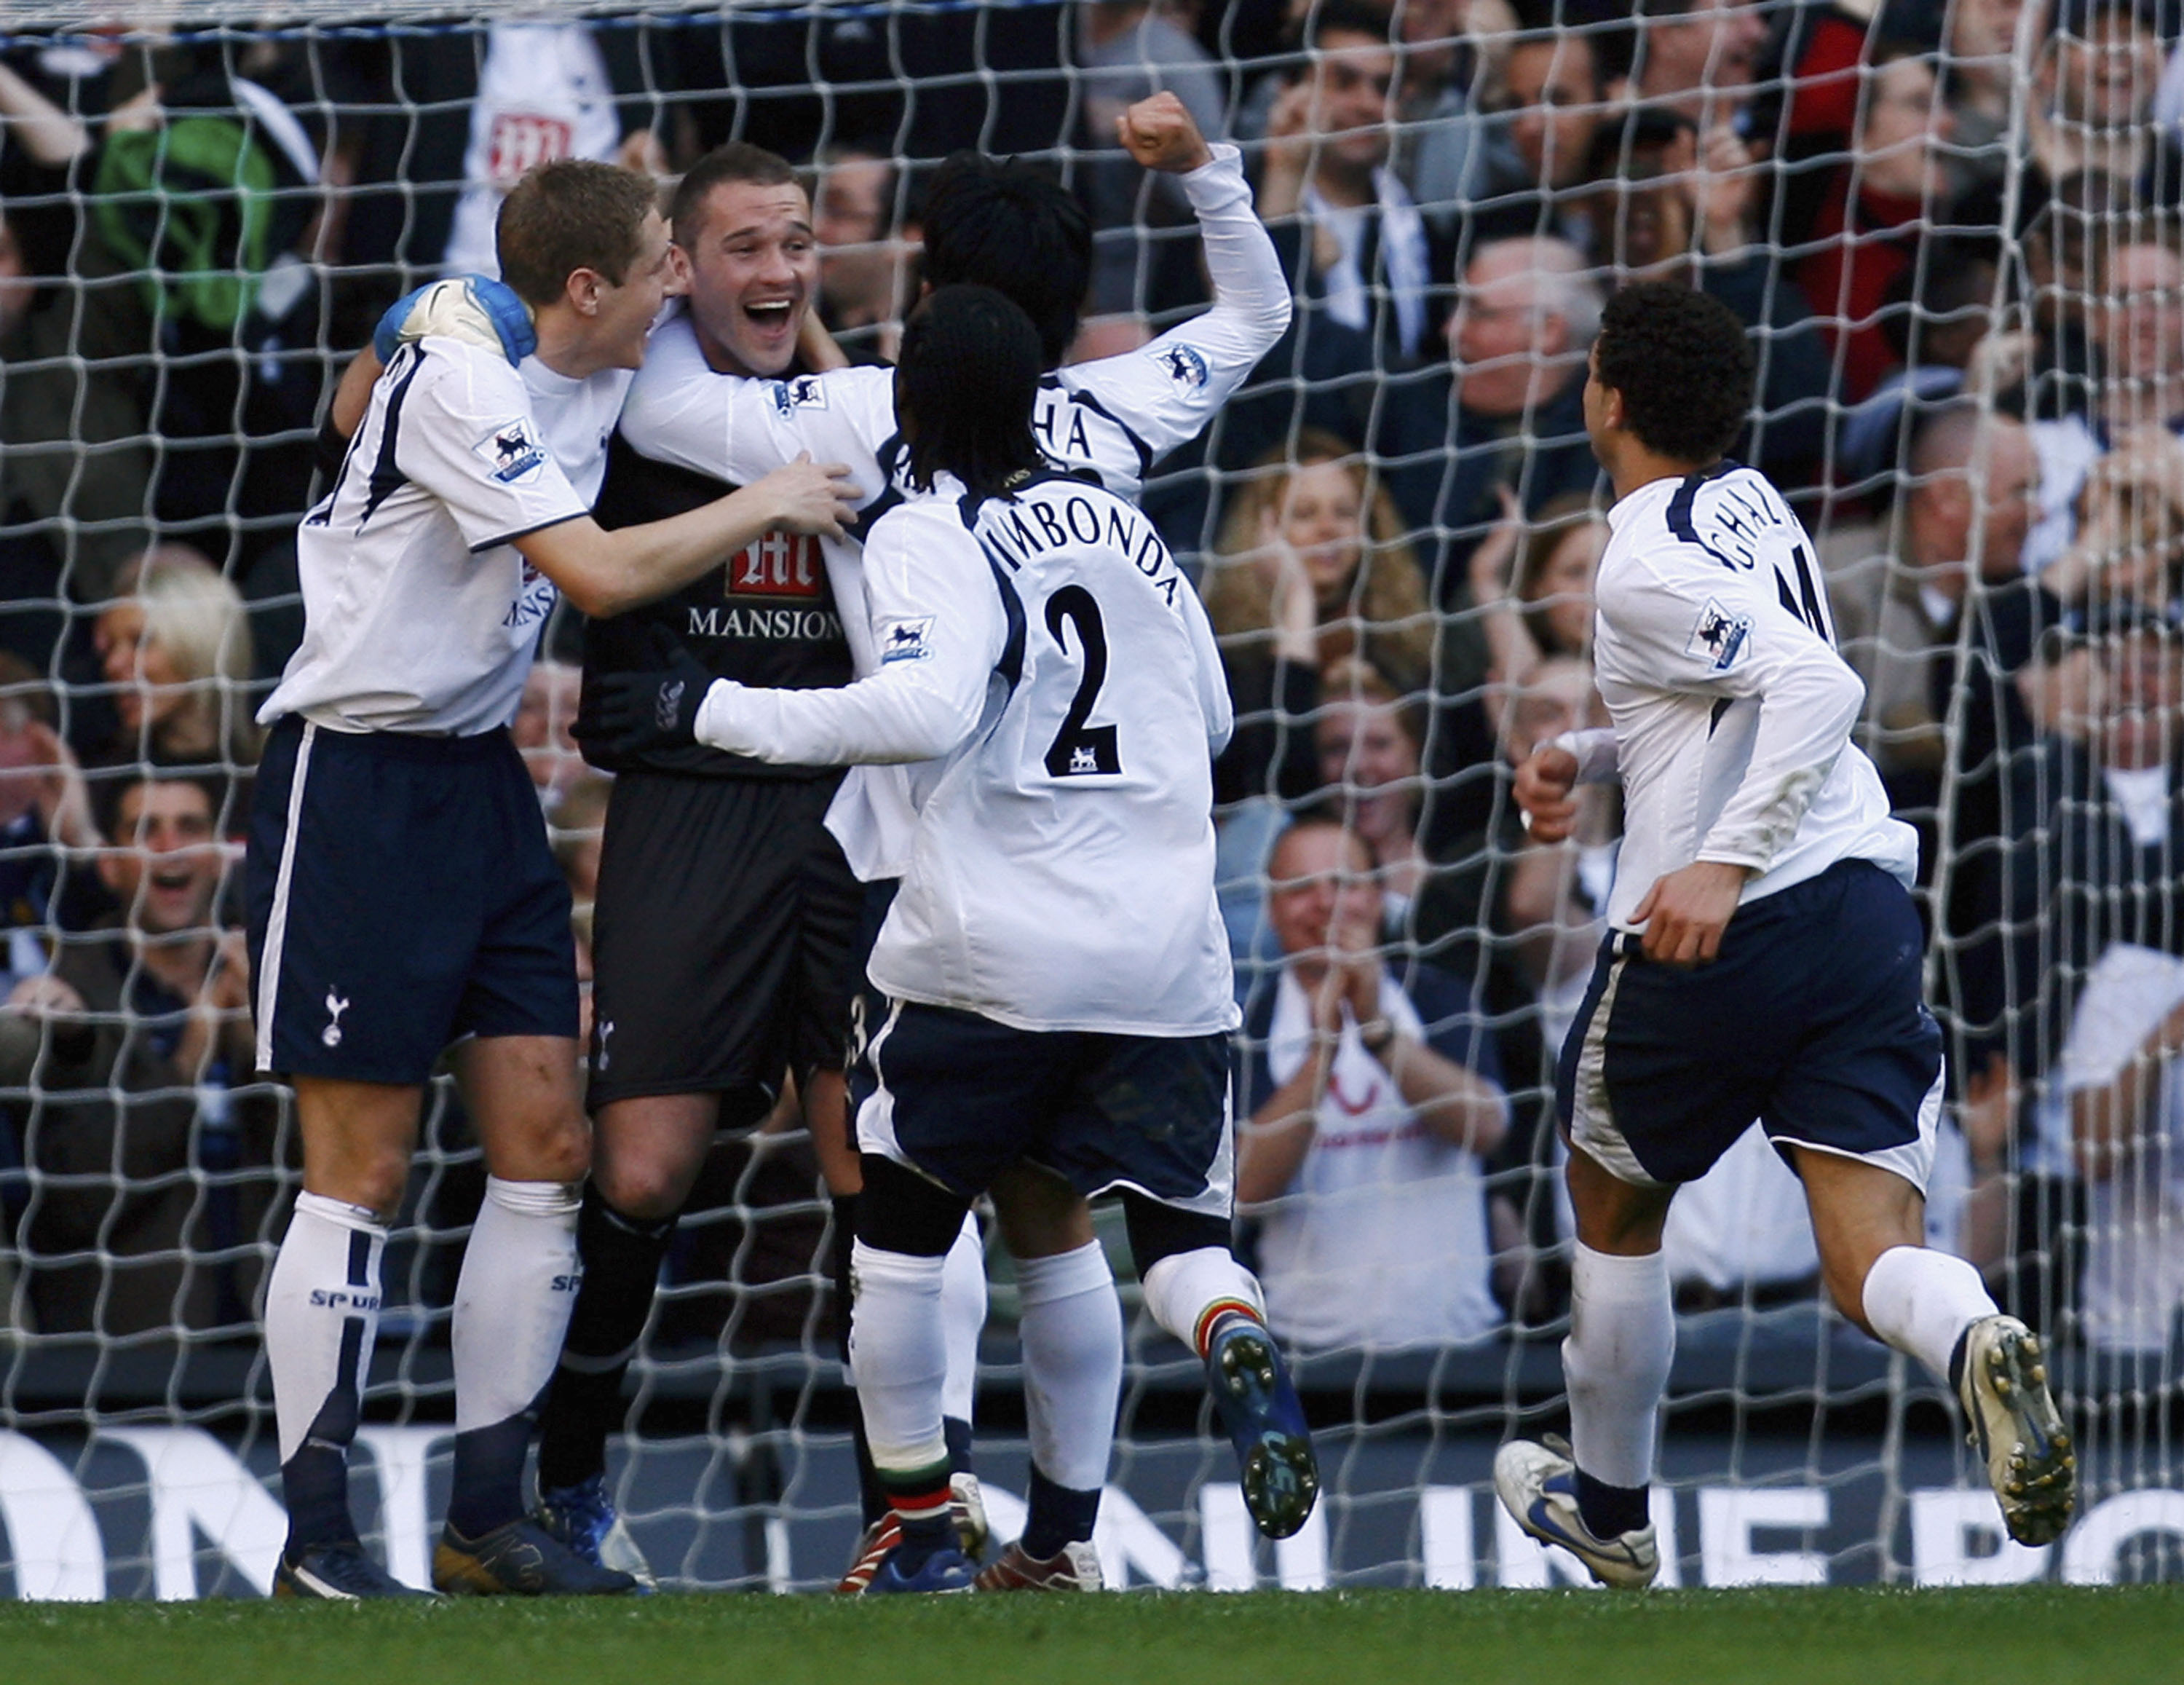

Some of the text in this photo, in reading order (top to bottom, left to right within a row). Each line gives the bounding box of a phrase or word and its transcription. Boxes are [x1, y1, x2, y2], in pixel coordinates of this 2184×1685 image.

[1712, 479, 1797, 570] GHAL
[1044, 585, 1123, 778] 2
[844, 995, 868, 1066] 3
